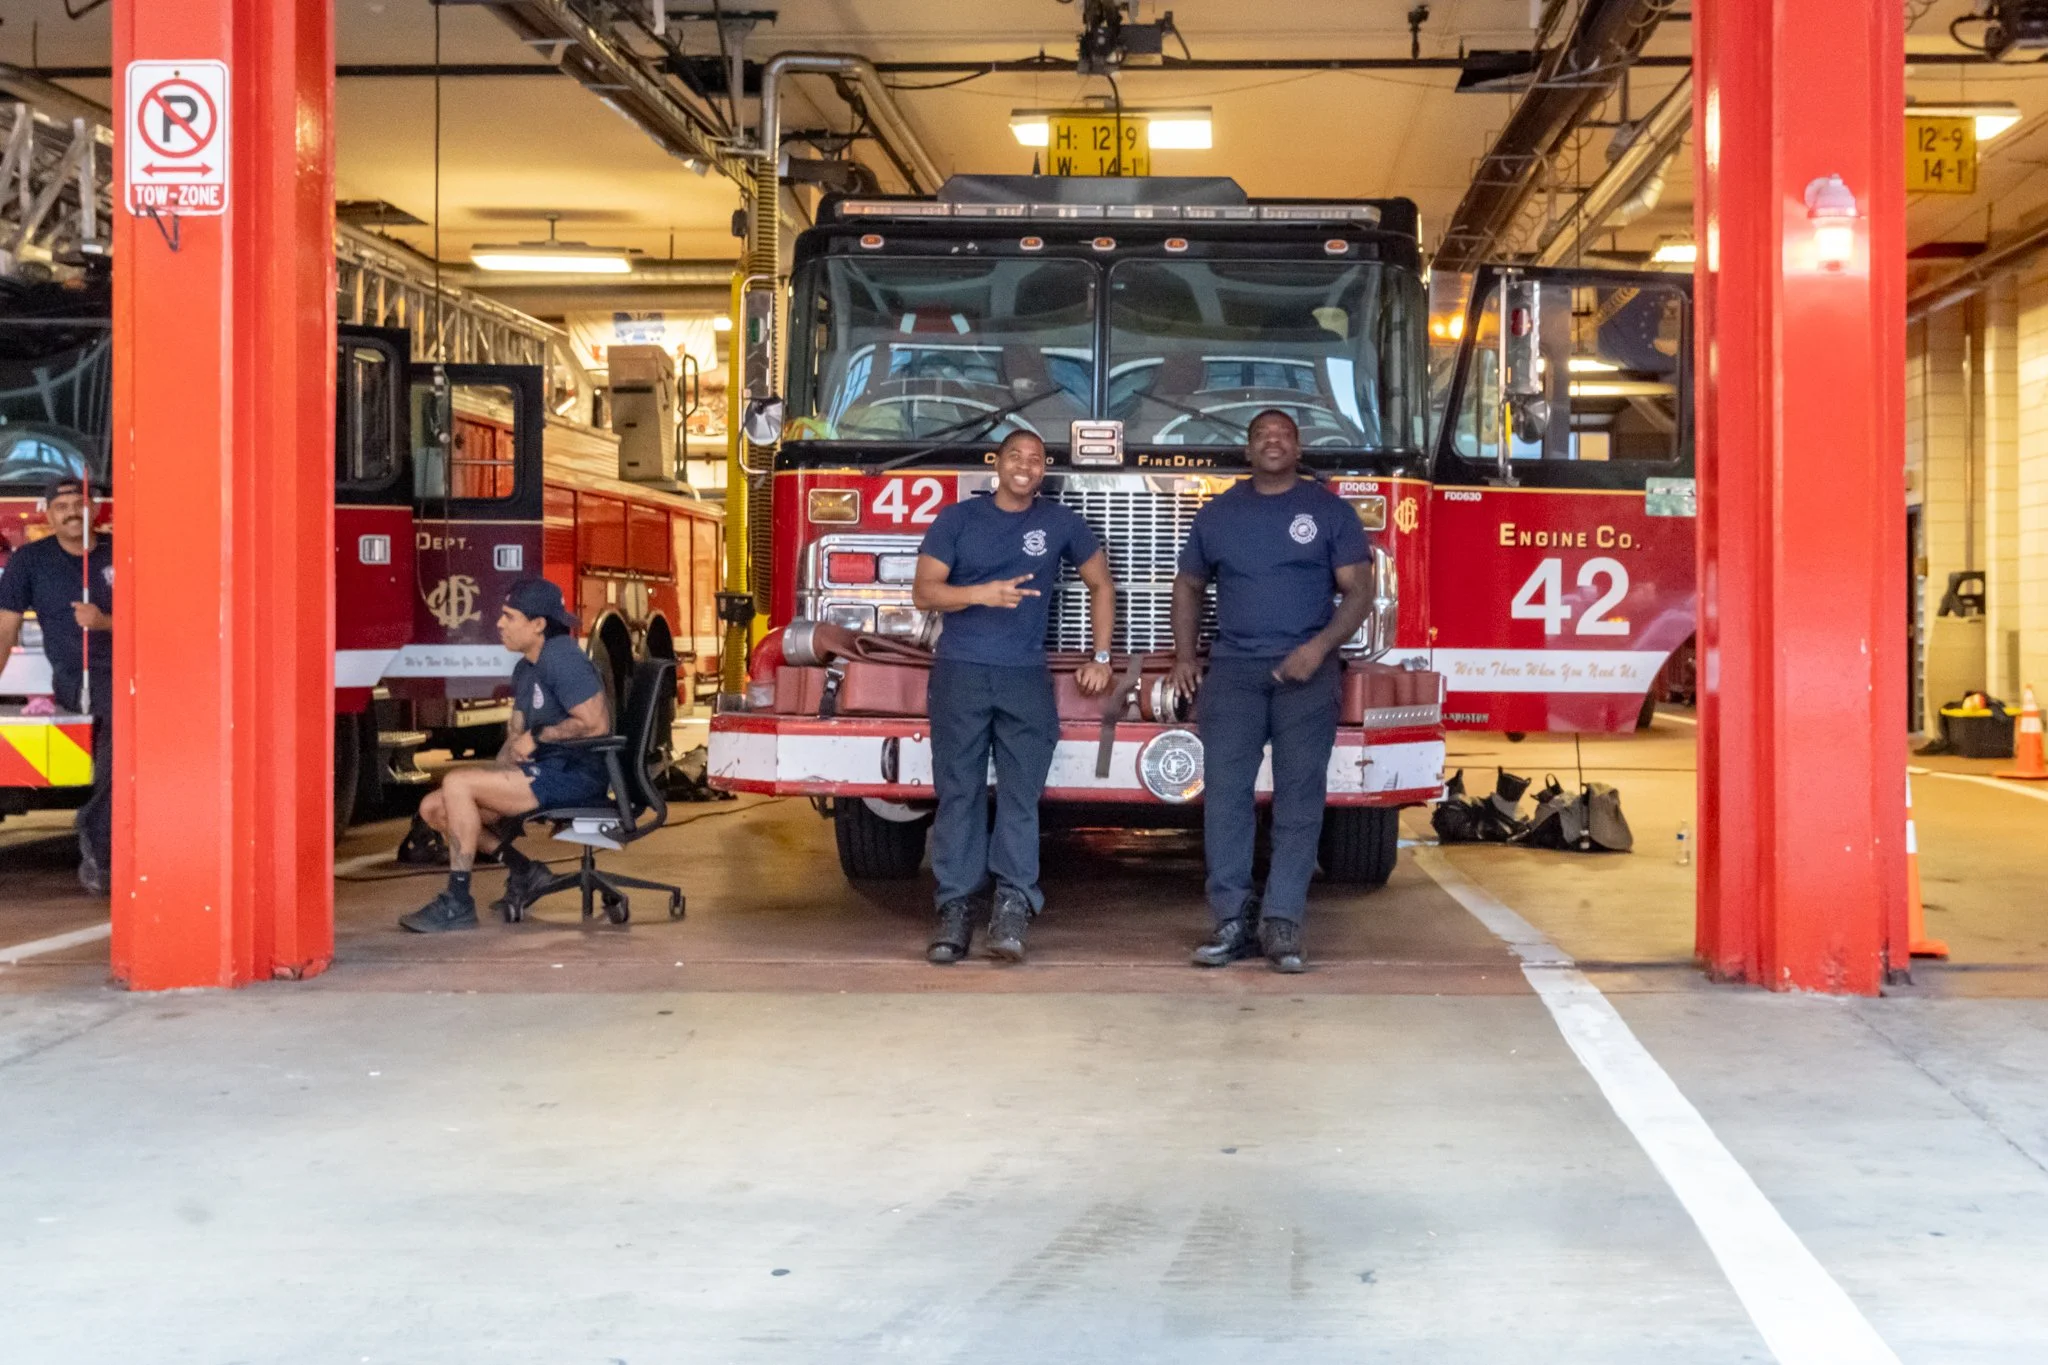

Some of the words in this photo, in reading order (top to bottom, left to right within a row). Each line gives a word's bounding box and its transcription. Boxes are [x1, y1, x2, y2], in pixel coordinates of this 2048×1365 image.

[1057, 125, 1077, 150] H:
[135, 184, 220, 206] TOW-ZONE
[872, 477, 944, 523] 42
[1500, 523, 1588, 548] ENGINE
[1511, 556, 1630, 636] 42
